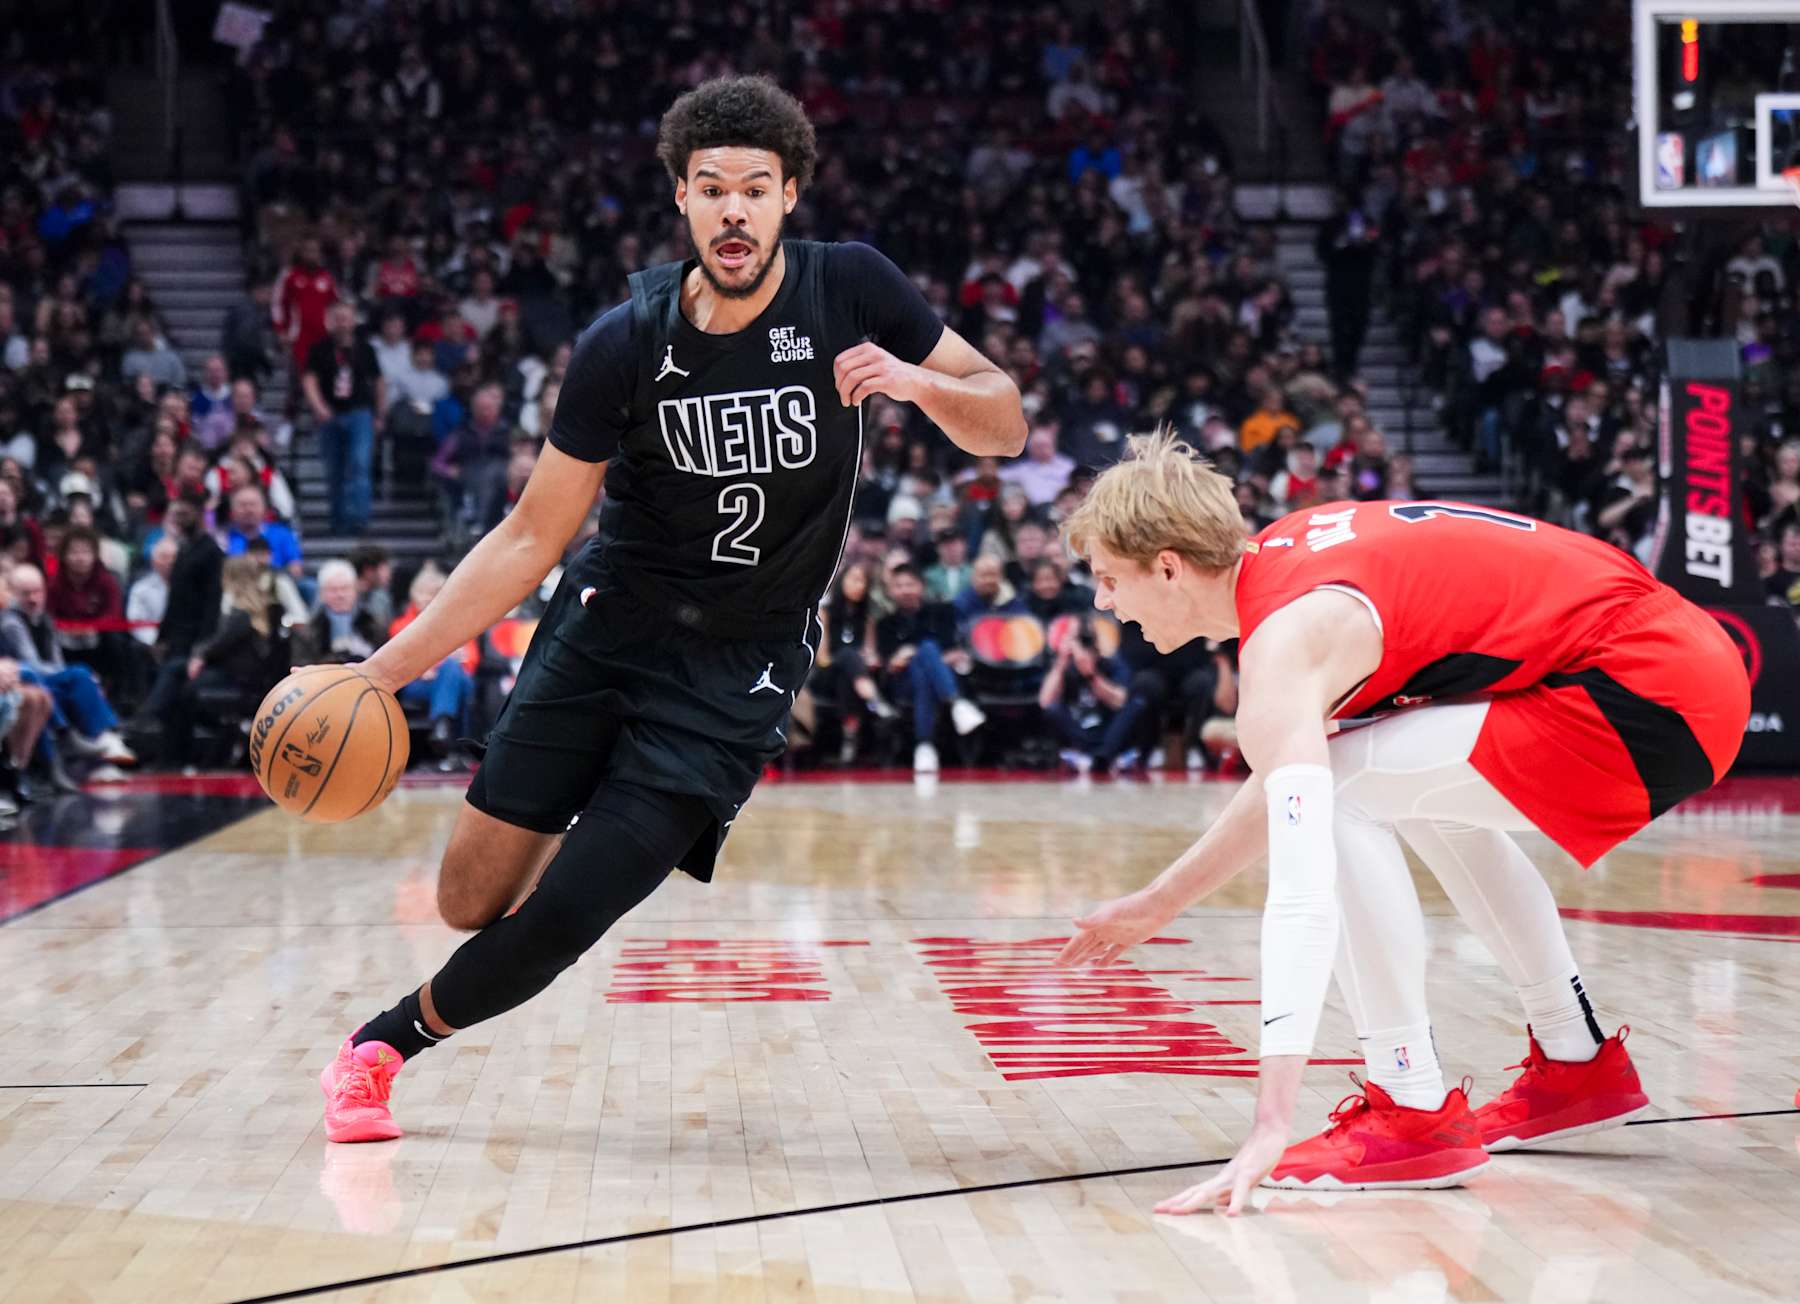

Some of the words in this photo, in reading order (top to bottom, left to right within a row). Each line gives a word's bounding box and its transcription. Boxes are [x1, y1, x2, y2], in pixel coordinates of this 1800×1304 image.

[769, 326, 796, 340] GET
[770, 336, 811, 351] YOUR
[771, 348, 814, 363] GUIDE
[658, 385, 817, 477] NETS
[1685, 383, 1733, 589] POINTSBET
[711, 483, 766, 566] 2
[1389, 503, 1537, 532] 1
